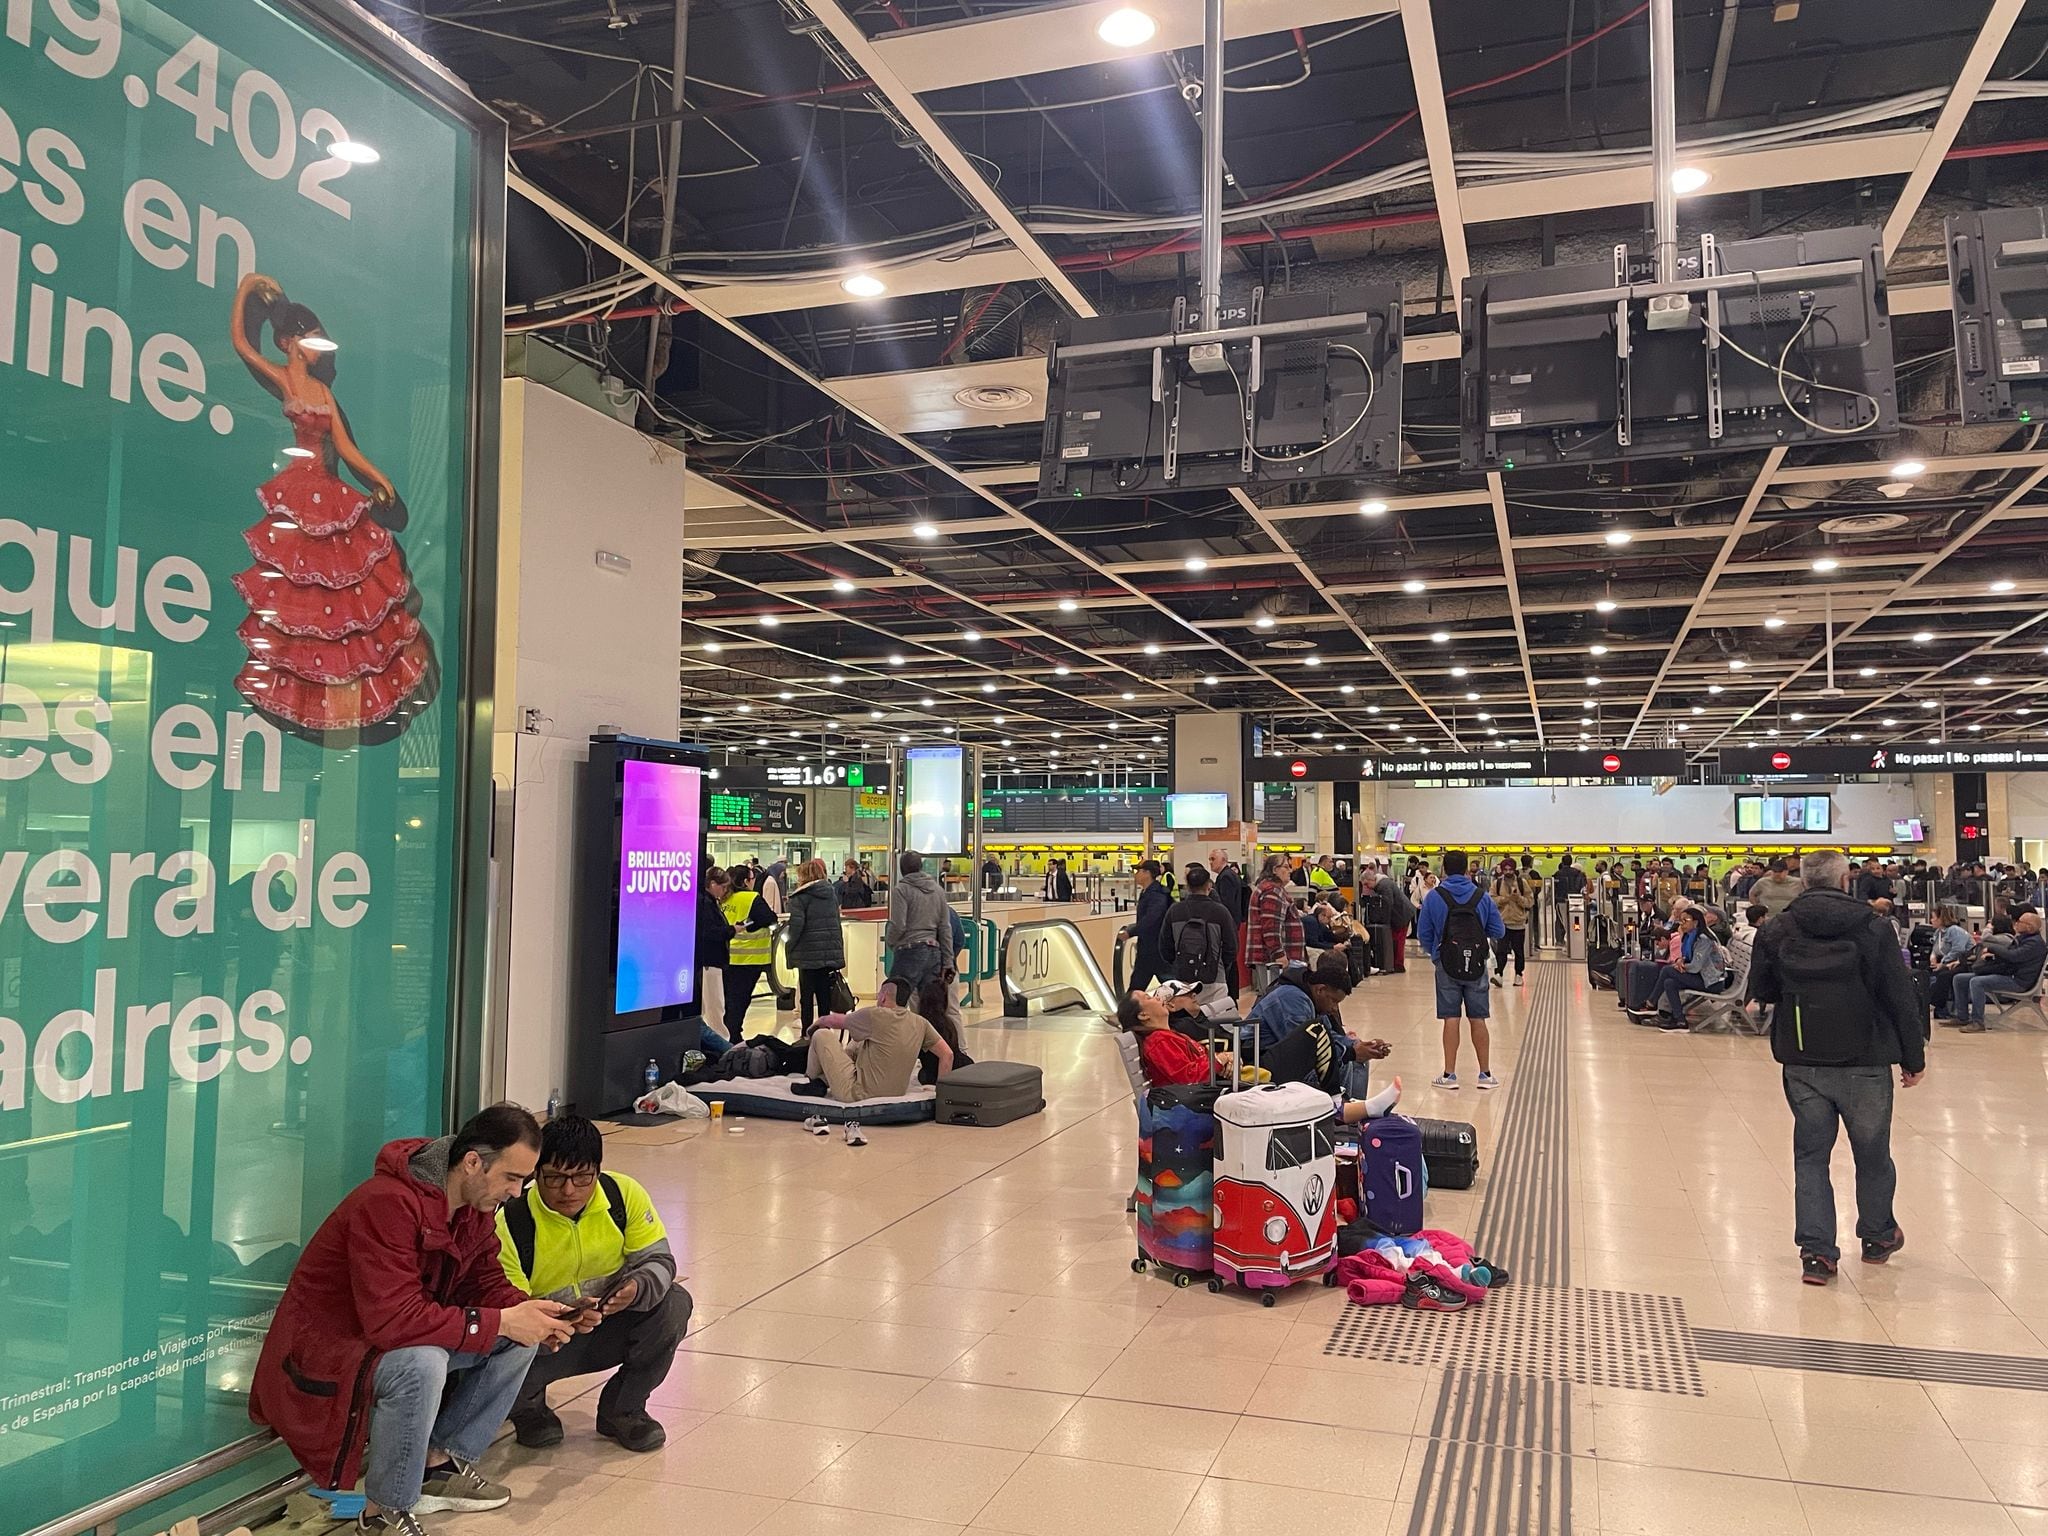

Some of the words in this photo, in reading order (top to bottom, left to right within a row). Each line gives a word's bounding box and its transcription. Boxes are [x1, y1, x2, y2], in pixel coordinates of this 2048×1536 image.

[123, 177, 257, 289] en
[1629, 256, 1699, 276] PHPS
[1188, 307, 1247, 325] PIPS
[0, 518, 212, 644] que
[0, 682, 113, 784] es
[151, 703, 283, 793] en
[1895, 753, 1911, 764] No
[1912, 753, 1945, 766] pasar
[1953, 752, 1971, 763] No
[1381, 761, 1395, 772] No
[1396, 761, 1422, 774] pasar
[1429, 761, 1443, 771] No
[1445, 760, 1478, 773] passeu
[252, 818, 371, 929] de
[626, 869, 692, 894] JUNTOS
[628, 850, 693, 869] BRILLEMOS
[0, 1377, 71, 1411] Trimestral:
[74, 1356, 140, 1387] Transporte
[142, 1348, 158, 1364] de
[159, 1331, 205, 1356] Viajeros
[206, 1325, 226, 1343] por
[11, 1415, 30, 1430] de
[32, 1397, 80, 1423] España
[83, 1389, 105, 1409] por
[106, 1382, 119, 1397] la
[120, 1361, 180, 1392] capacidad
[182, 1347, 216, 1369] media
